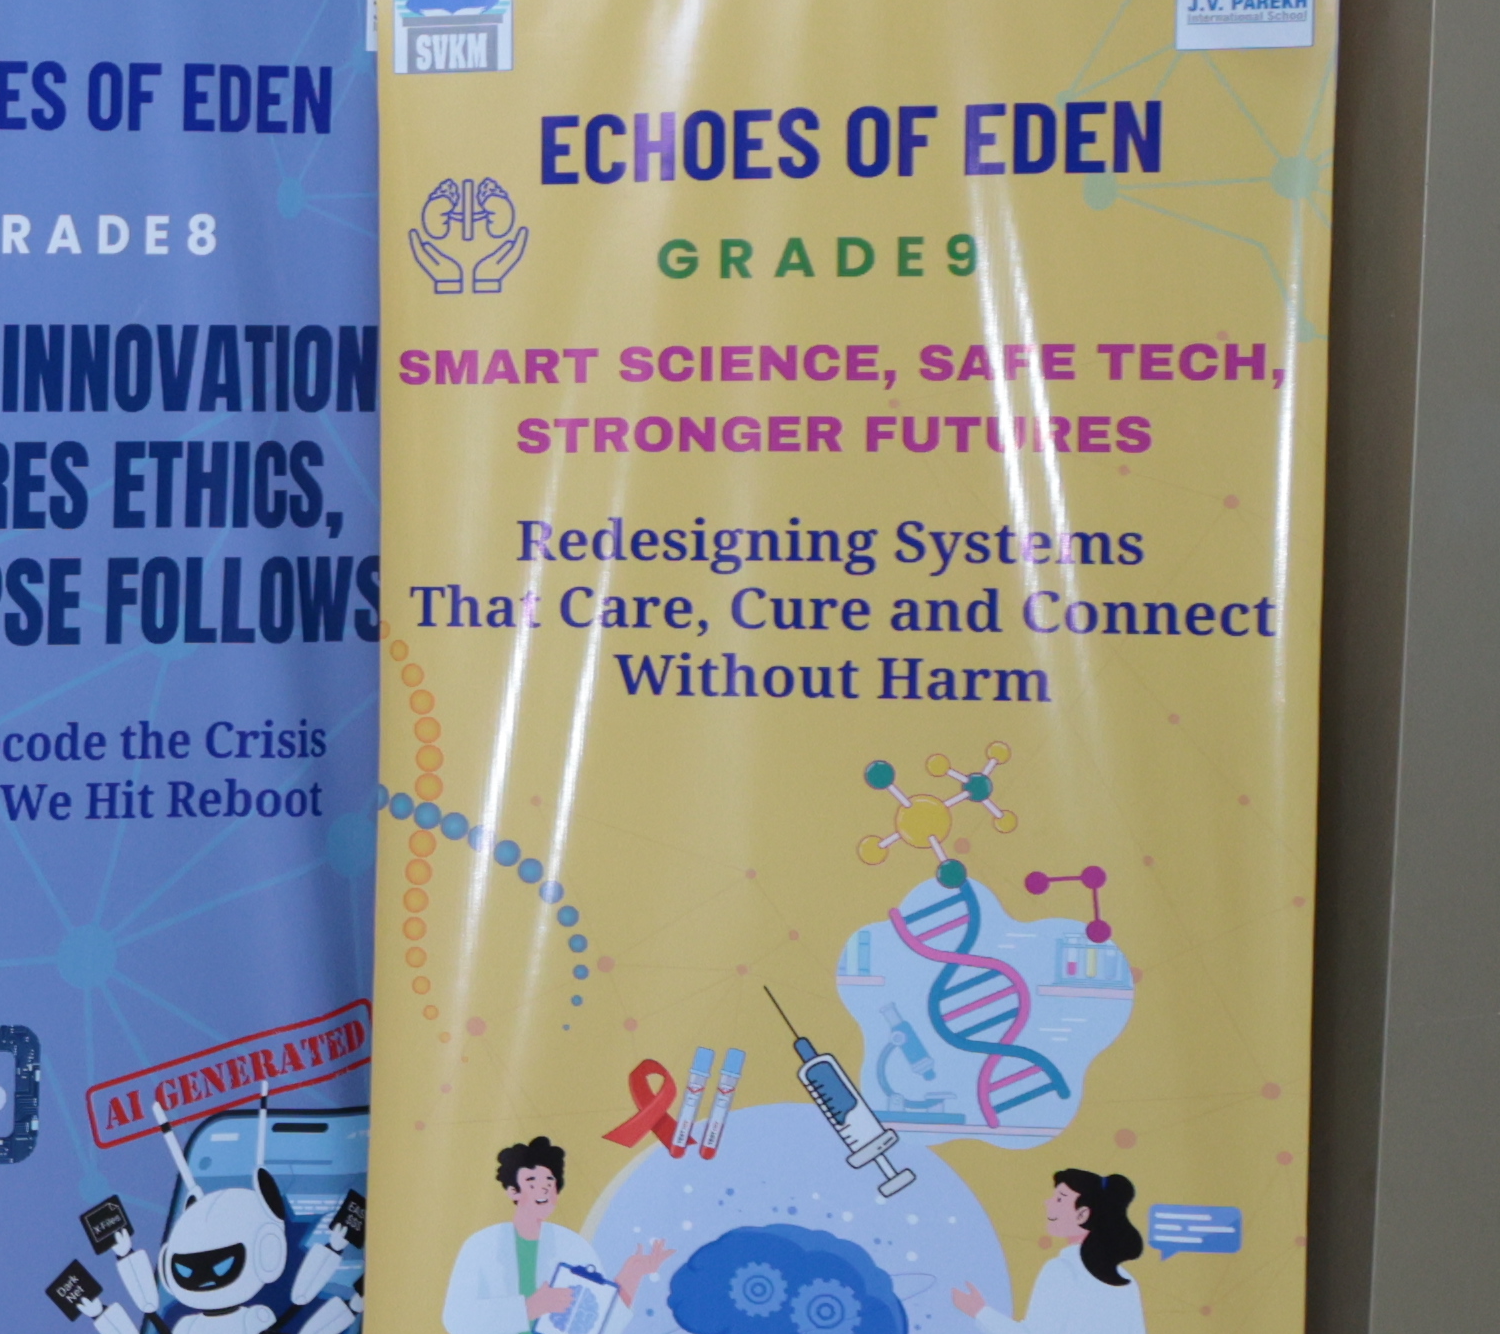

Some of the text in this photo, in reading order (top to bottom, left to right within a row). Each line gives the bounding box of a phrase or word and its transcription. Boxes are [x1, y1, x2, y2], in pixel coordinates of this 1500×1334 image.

[415, 32, 488, 71] SVKM
[88, 61, 162, 132] OF
[183, 63, 332, 136] EDEN
[541, 100, 1162, 185] ECHOES OF EDEN
[2, 323, 379, 413] INNOVATION
[398, 342, 1285, 390] SMART SCIENCE, SAFE TECH,
[516, 415, 1153, 455] STRONGER FUTURES
[113, 439, 344, 539] ETHICS,
[516, 517, 1145, 576] Redesigning Systems
[105, 555, 381, 646] FOLLOWS
[410, 585, 1277, 637] That Care, Cure and Connect
[615, 652, 1051, 703] Without Harm
[121, 722, 190, 761] the
[205, 720, 326, 760] Crisis
[0, 783, 72, 823] We
[85, 781, 153, 821] Hit
[167, 780, 323, 820] Reboot
[105, 1021, 367, 1130] AI GENERATED
[56, 1274, 80, 1298] Dark
